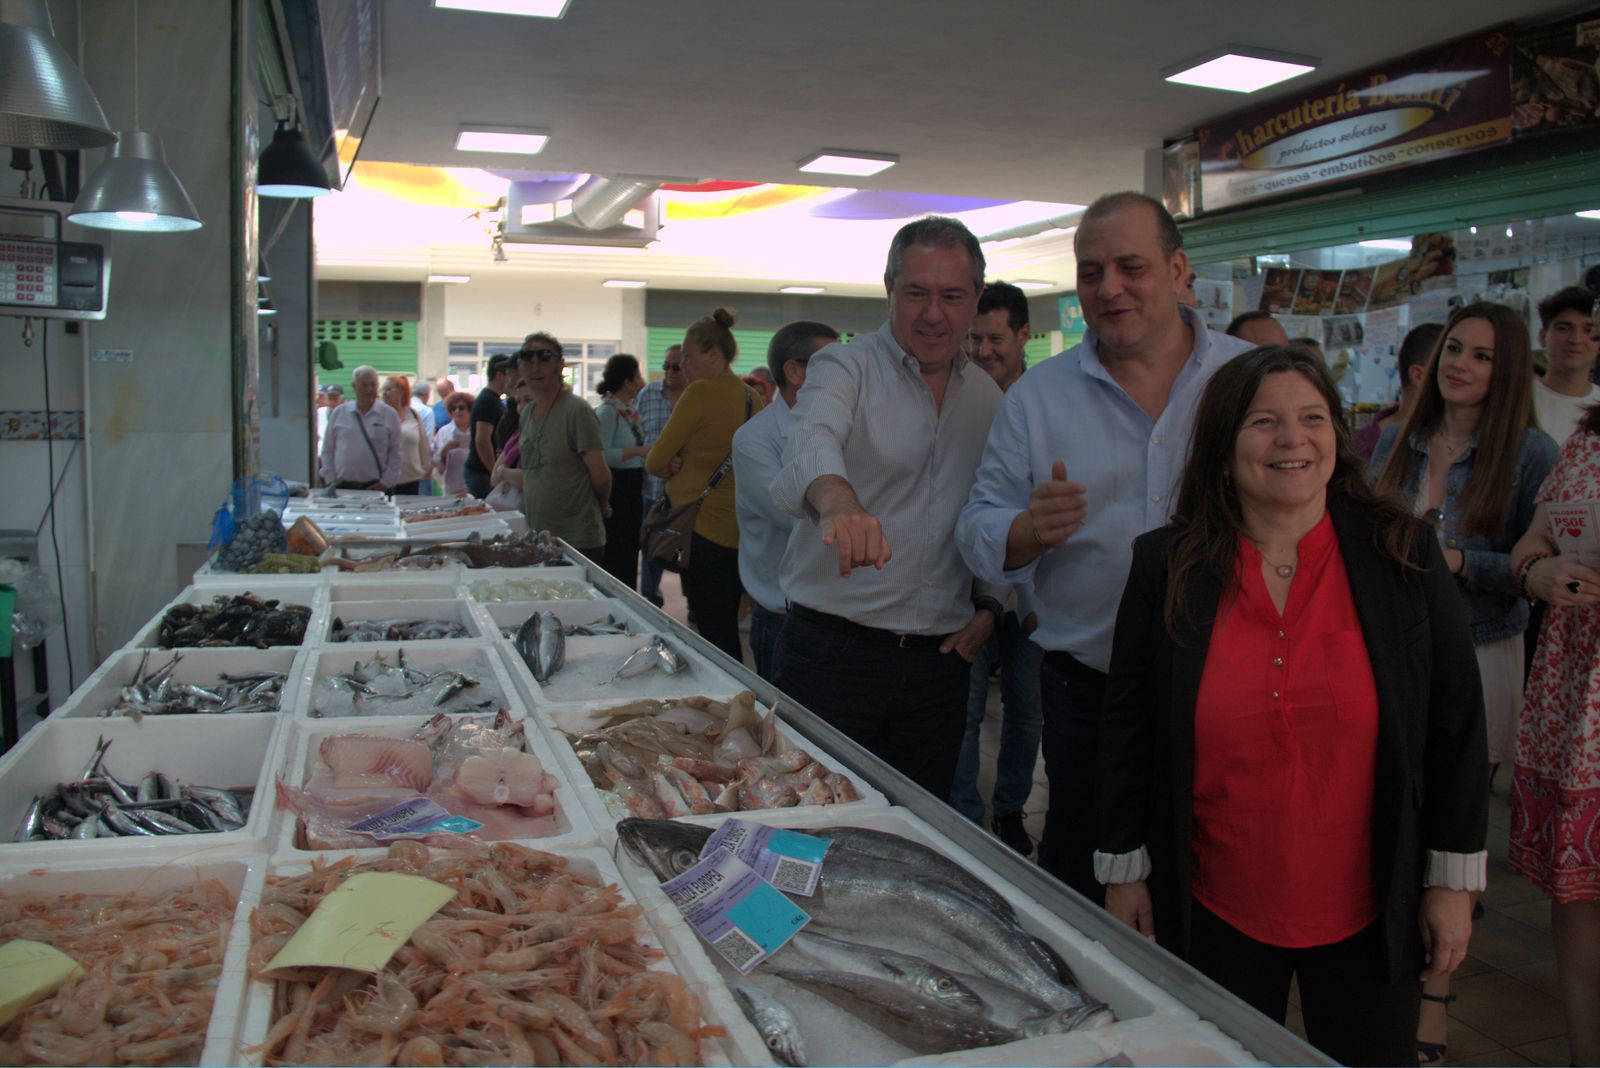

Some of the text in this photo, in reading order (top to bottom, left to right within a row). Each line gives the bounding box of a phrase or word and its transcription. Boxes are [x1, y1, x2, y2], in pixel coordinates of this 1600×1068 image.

[1220, 81, 1360, 160] Charcutería
[1265, 171, 1311, 192] quesos
[1319, 151, 1397, 178] embutidos
[1406, 126, 1498, 157] conservas
[1276, 121, 1388, 164] productos selectos
[1554, 517, 1586, 527] PSOE
[695, 868, 726, 894] EUROPEA
